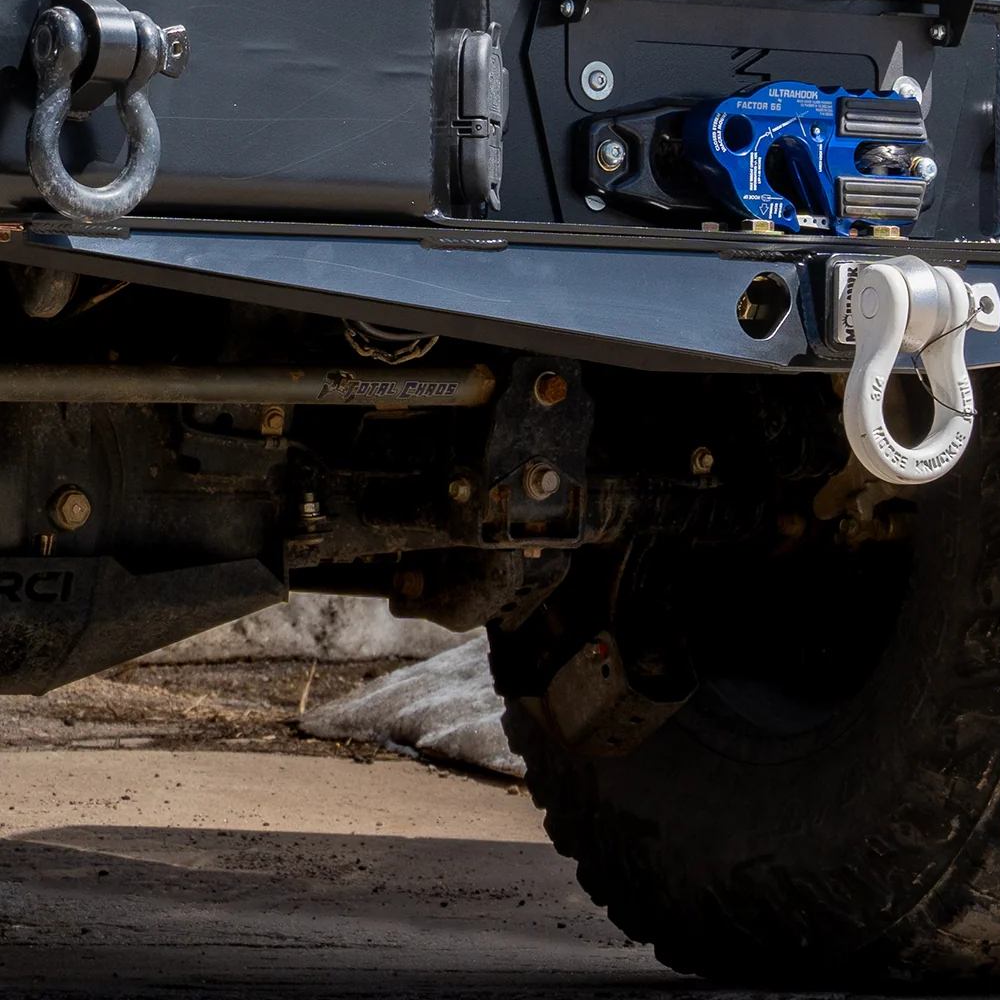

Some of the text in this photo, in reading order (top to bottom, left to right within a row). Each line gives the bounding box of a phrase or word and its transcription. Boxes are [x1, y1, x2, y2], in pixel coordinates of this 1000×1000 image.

[768, 88, 819, 100] ULTRAHOOK
[736, 100, 769, 111] FACTOR
[344, 379, 459, 400] TOTAL CHAOS
[872, 425, 968, 475] MOOSE KNUCKLE
